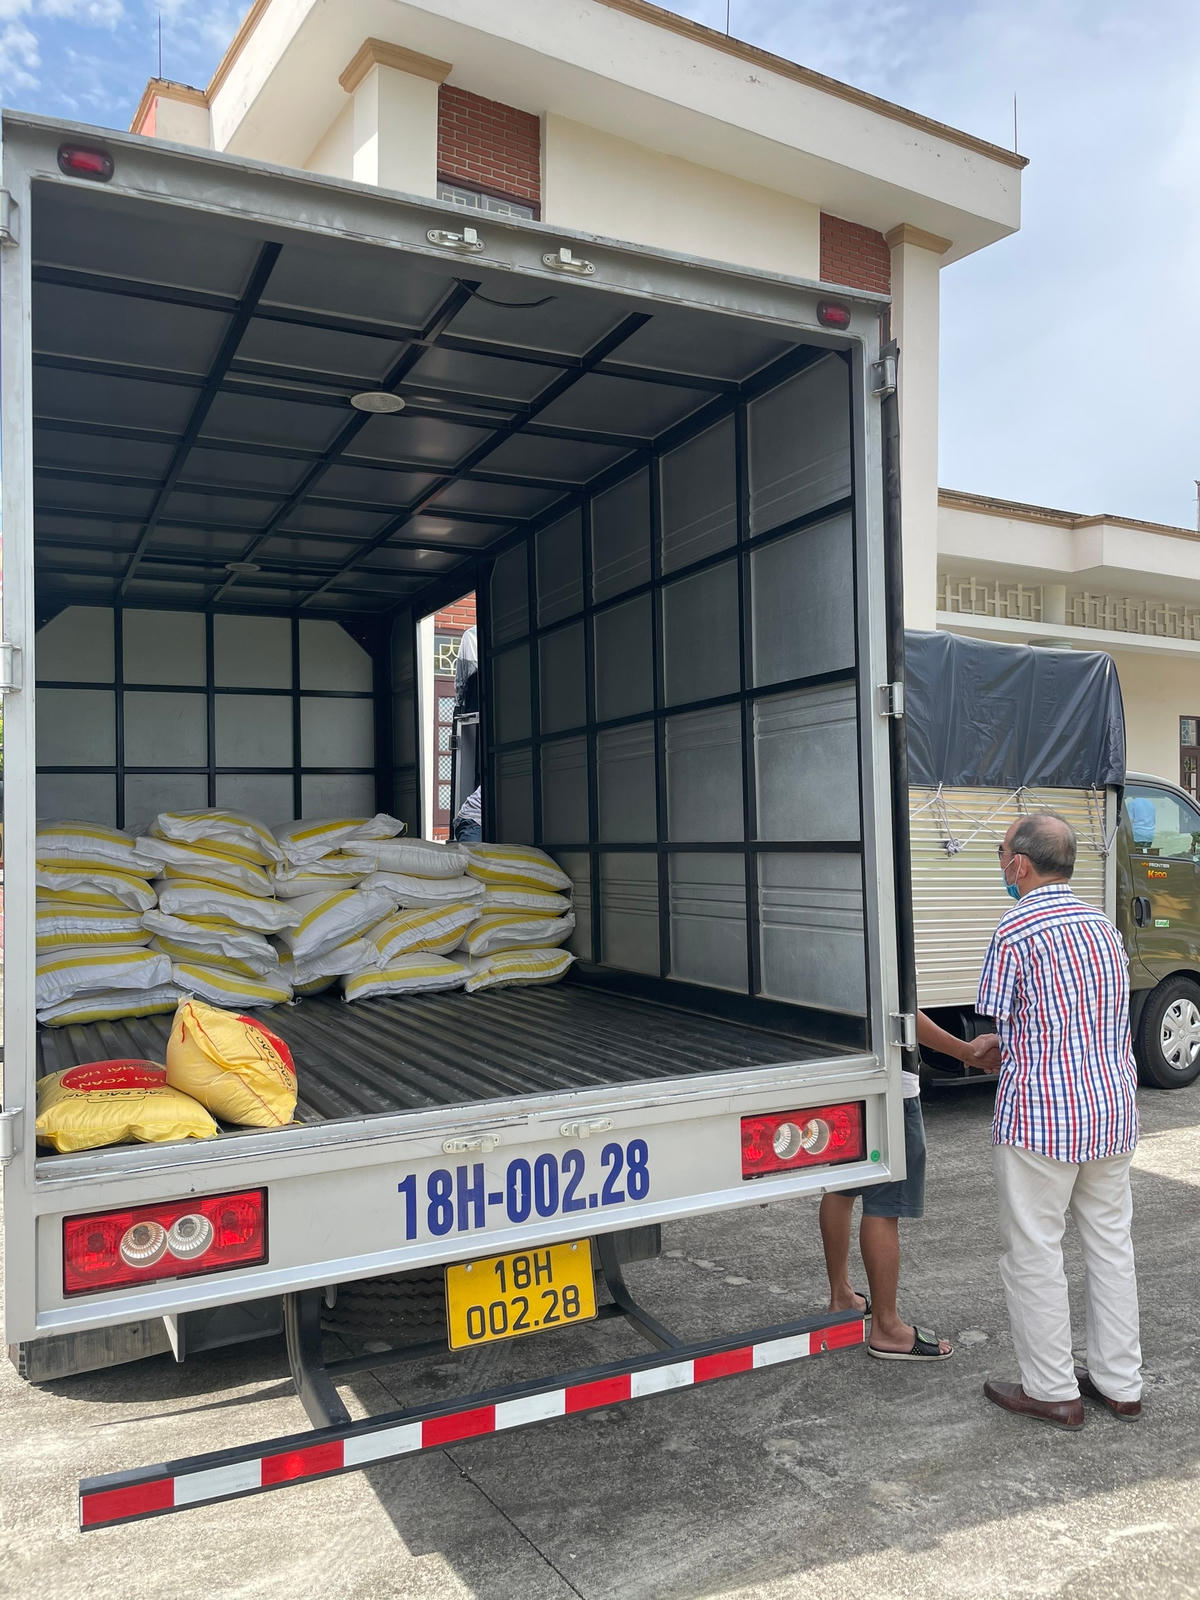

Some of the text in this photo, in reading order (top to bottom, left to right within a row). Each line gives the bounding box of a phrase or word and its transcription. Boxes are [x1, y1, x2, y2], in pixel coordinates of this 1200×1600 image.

[1147, 869, 1169, 879] K200
[397, 1138, 650, 1241] 18H-002.28
[494, 1250, 553, 1293] 18H
[466, 1284, 581, 1340] 002.28
